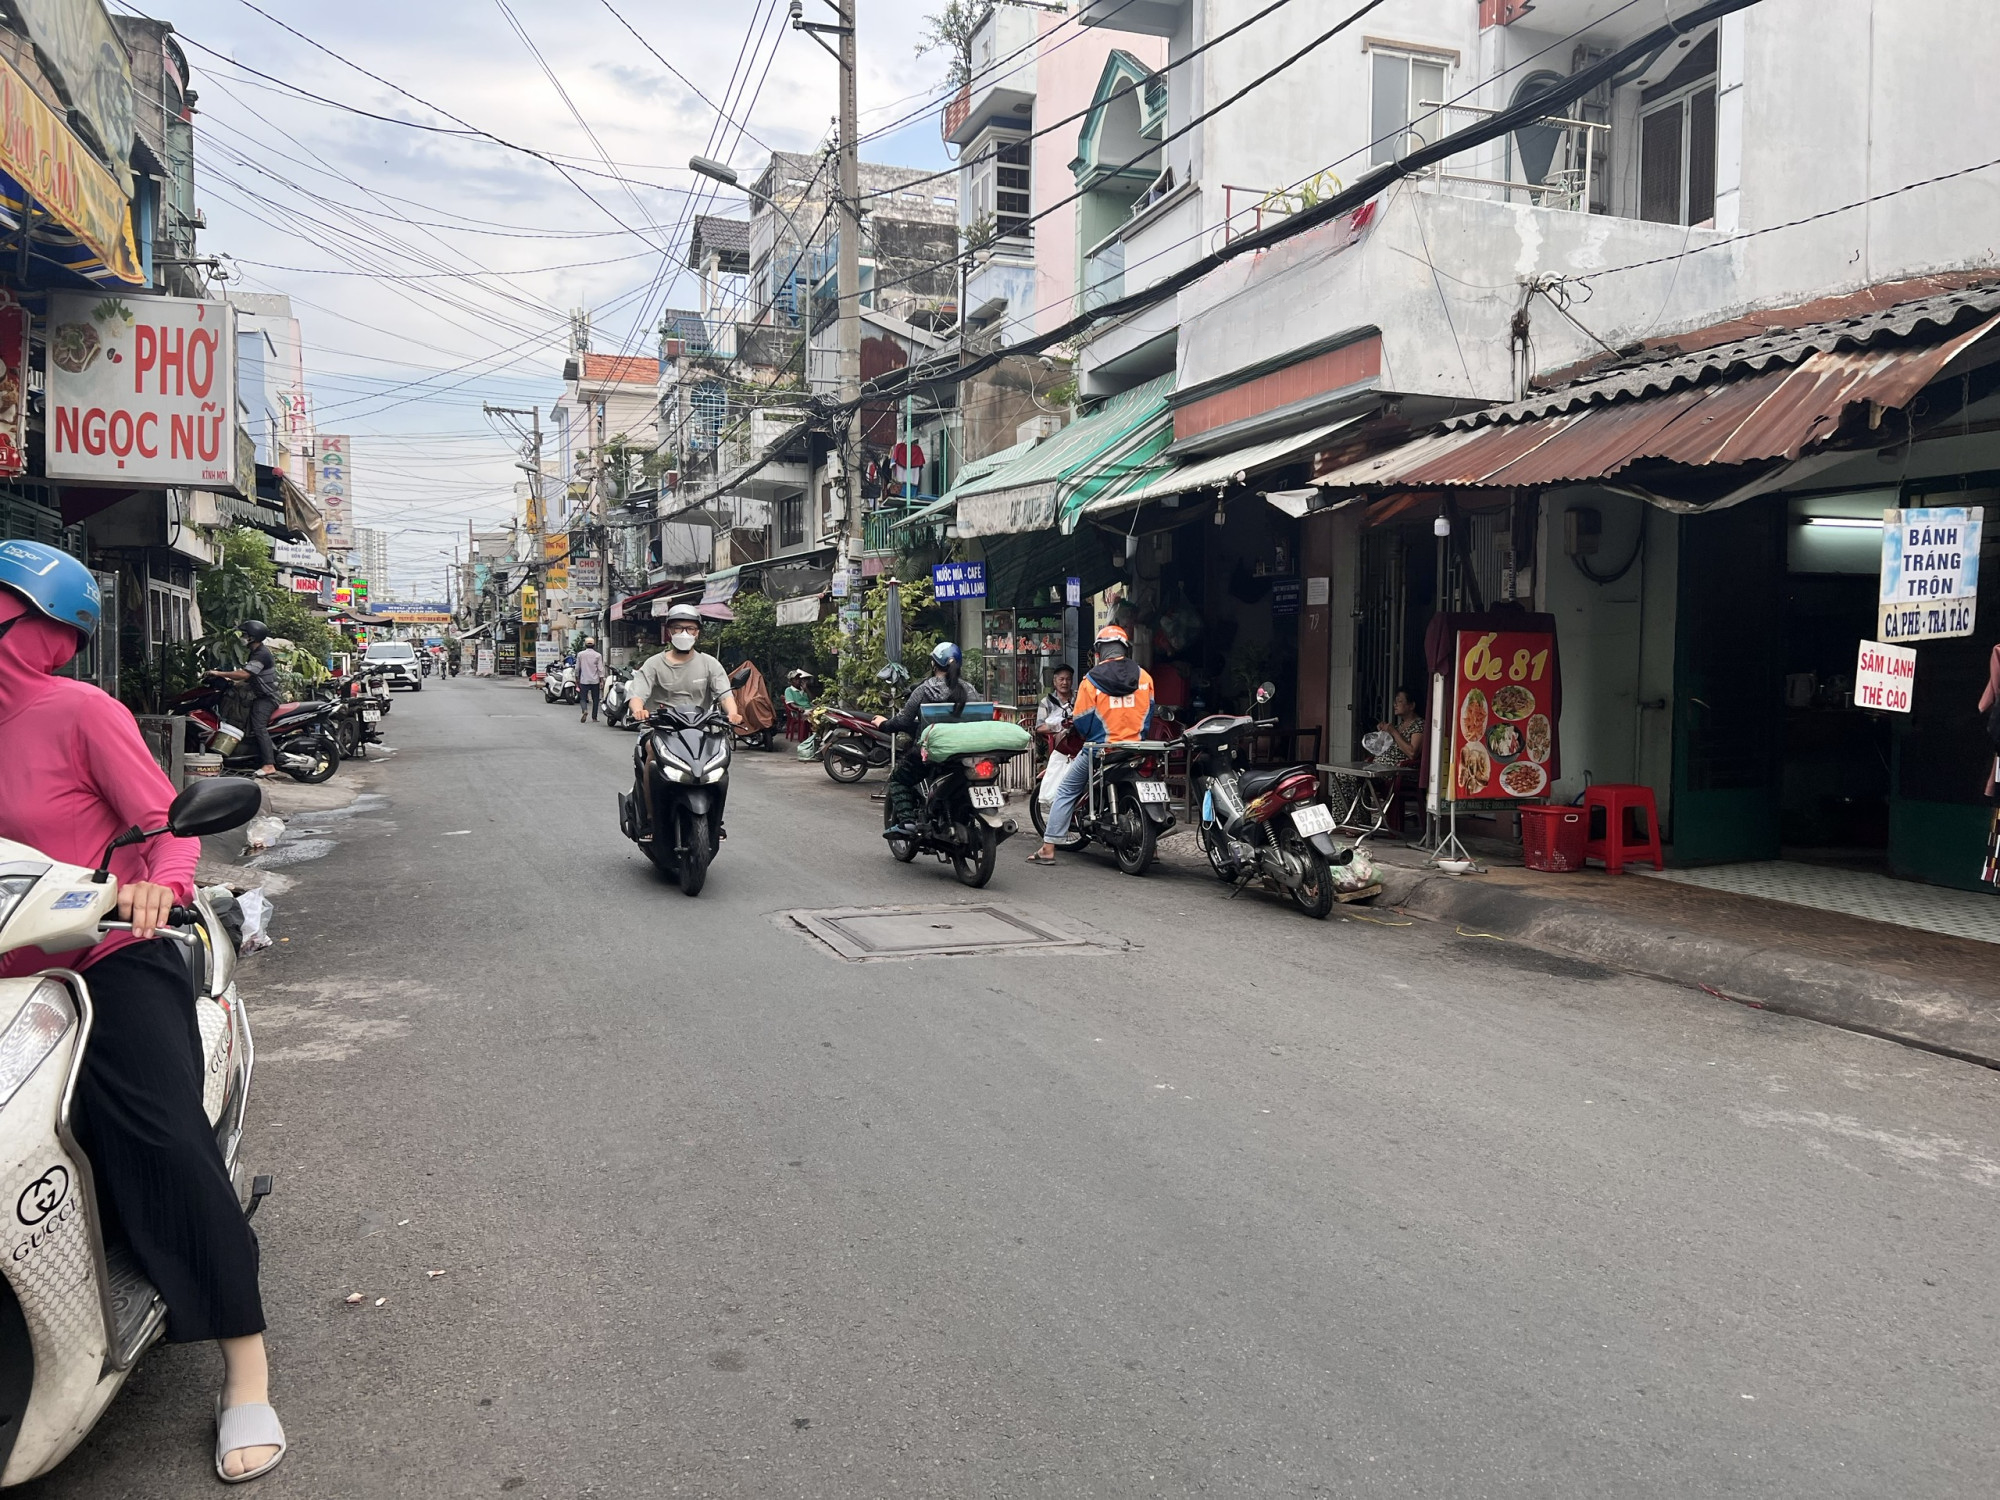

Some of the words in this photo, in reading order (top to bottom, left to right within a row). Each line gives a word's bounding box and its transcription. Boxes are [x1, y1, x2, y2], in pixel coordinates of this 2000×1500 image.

[135, 304, 218, 398] PHỞ
[55, 406, 158, 469] NGỌC
[171, 401, 226, 462] NỮ
[1909, 525, 1958, 546] BÁNH
[936, 565, 952, 582] NƯỚC
[952, 565, 964, 581] MÍA
[1904, 551, 1962, 572] TRÁNG
[935, 584, 946, 597] RAU
[946, 581, 956, 597] MÁ
[959, 581, 971, 596] DỪA
[970, 581, 985, 597] LẠNH
[1908, 575, 1954, 598] TRỘN
[1309, 613, 1320, 630] 79
[1885, 605, 1899, 638] CÀ
[1901, 605, 1921, 635] PHÊ
[1928, 603, 1947, 633] TRÀ
[1950, 600, 1970, 631] TẮC
[1508, 648, 1549, 682] 81
[1860, 649, 1884, 673] SÂM
[1887, 655, 1914, 680] LẠNH
[1862, 681, 1883, 706] THẺ
[1887, 684, 1908, 709] CÀO
[976, 797, 1000, 806] 7652
[13, 1197, 76, 1261] GUCCI
